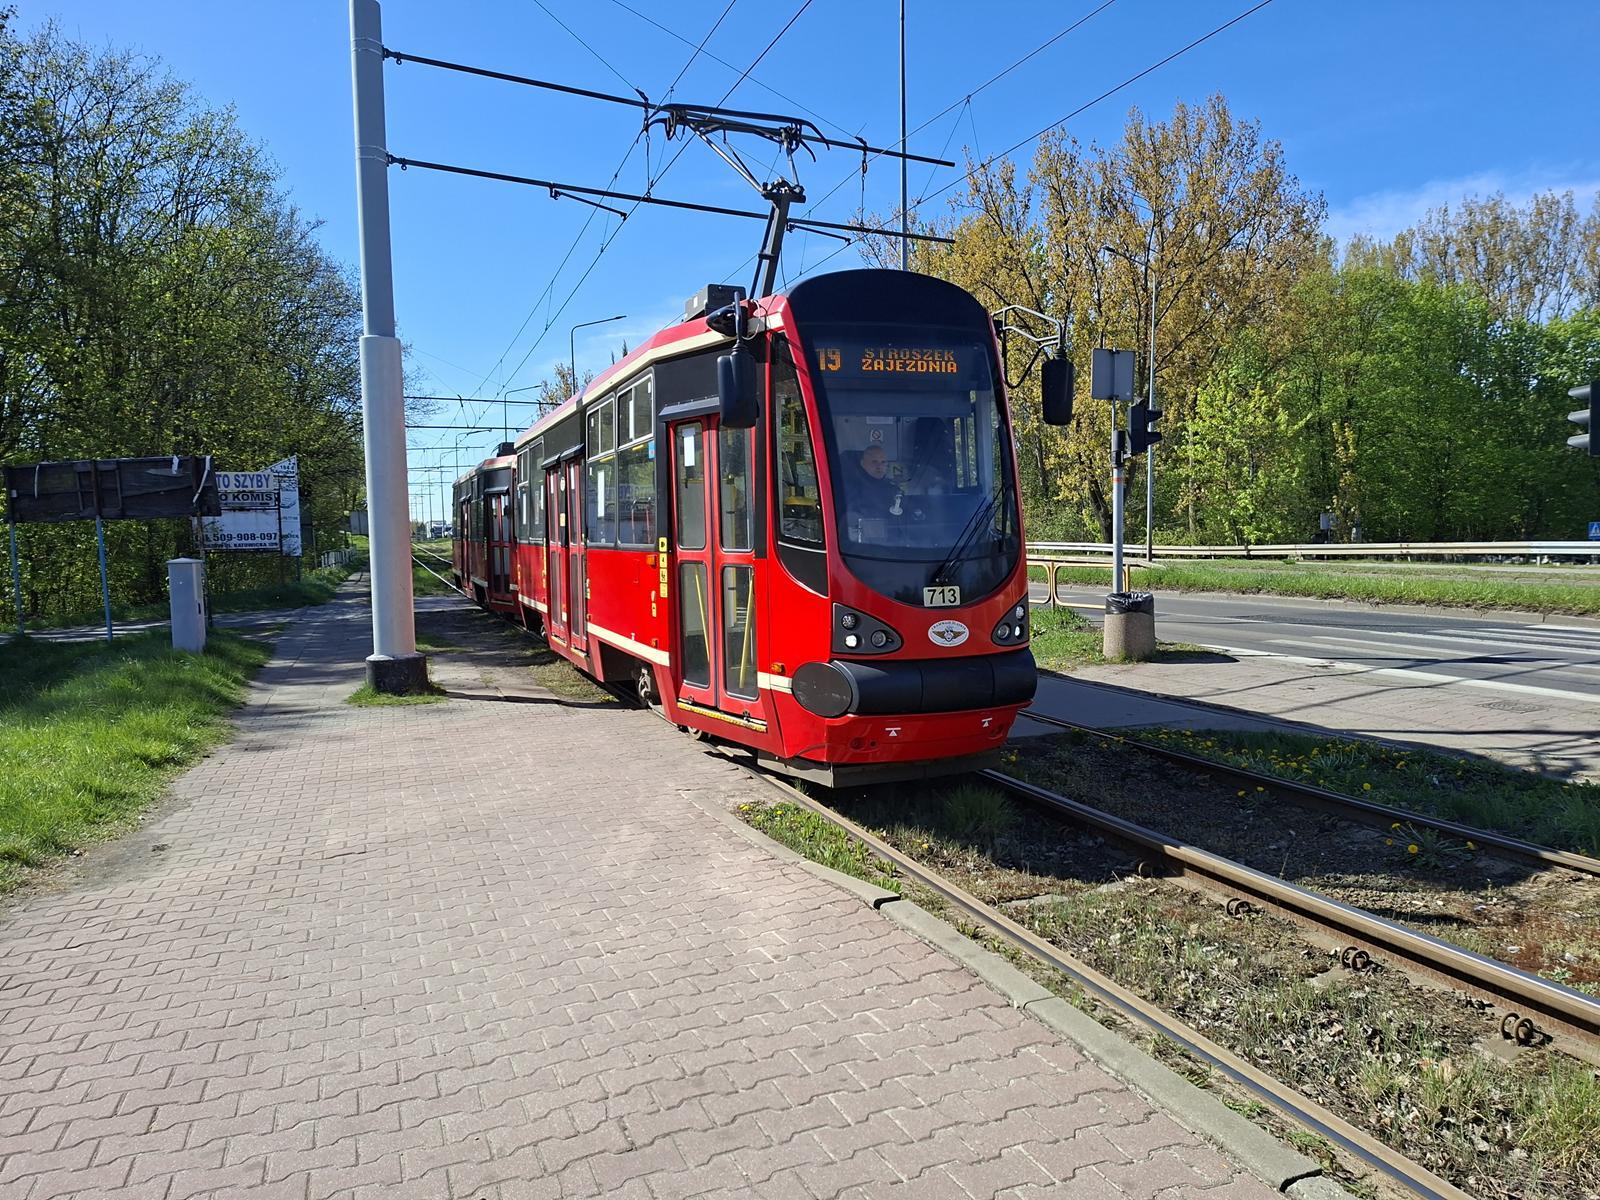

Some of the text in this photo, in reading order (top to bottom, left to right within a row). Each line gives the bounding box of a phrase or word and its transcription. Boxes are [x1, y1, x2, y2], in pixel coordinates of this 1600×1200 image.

[816, 348, 954, 371] 19 STROSZEK
[861, 358, 957, 373] ZAJEZDNIA
[234, 474, 270, 488] SZYBY
[233, 493, 273, 501] KOMIS
[213, 532, 278, 541] 509-908-097
[927, 588, 957, 604] 713
